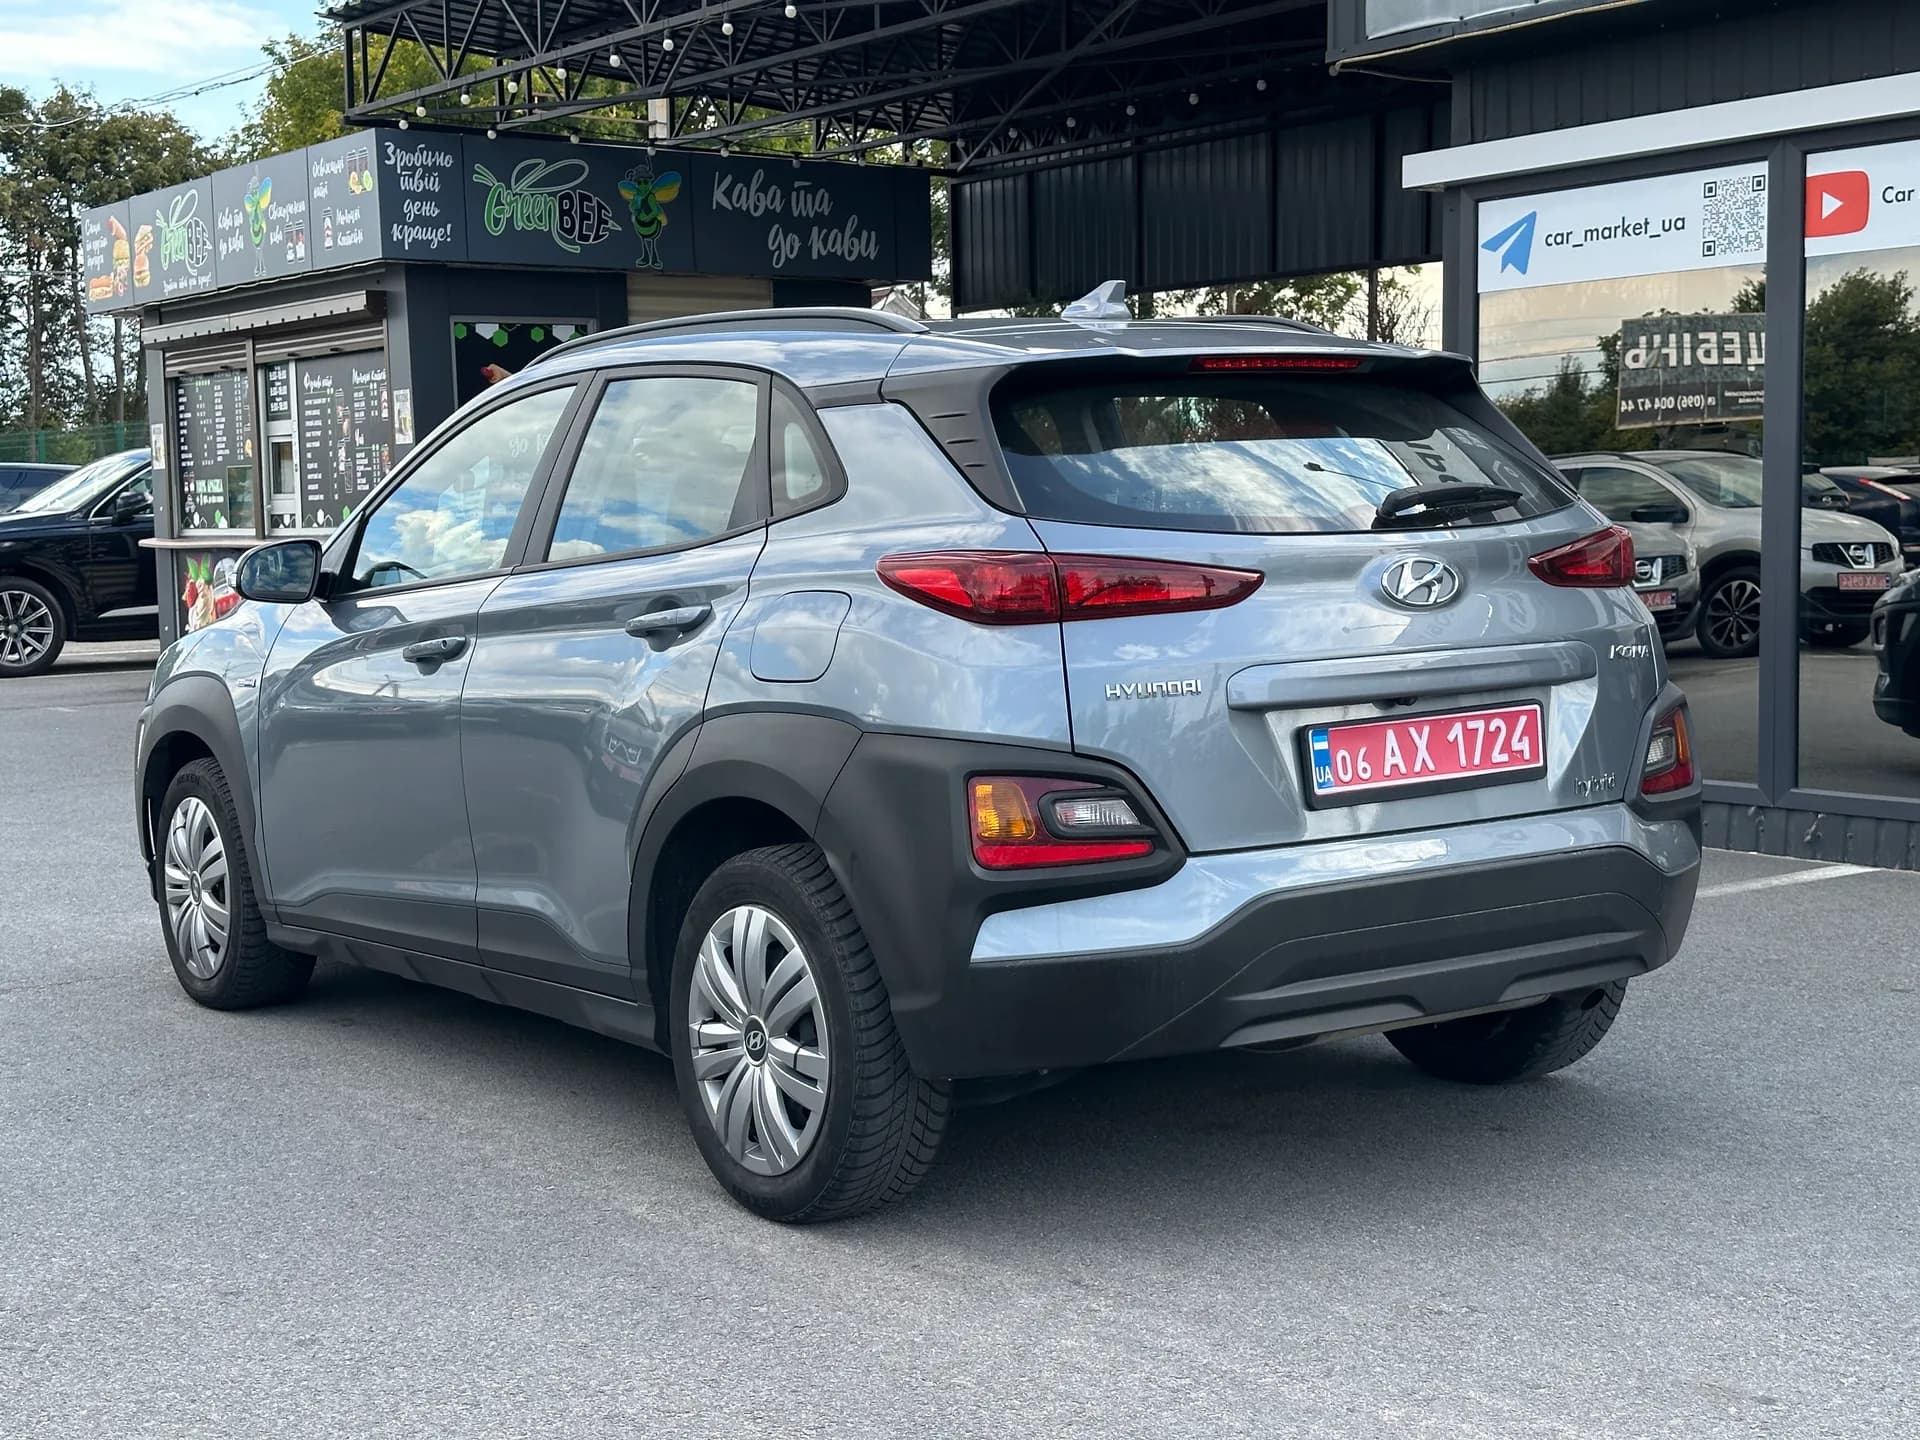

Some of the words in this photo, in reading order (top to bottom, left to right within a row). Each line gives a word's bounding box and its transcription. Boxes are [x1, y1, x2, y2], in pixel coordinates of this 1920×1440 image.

[384, 142, 453, 174] Зробимо
[400, 168, 441, 192] твій
[713, 169, 784, 216] Кава
[791, 181, 833, 218] та
[1882, 186, 1915, 204] Car
[403, 199, 440, 222] день
[391, 223, 452, 250] краще!
[768, 224, 802, 268] до
[808, 215, 879, 261] кави
[1544, 216, 1686, 248] car_market_ua
[1105, 680, 1201, 701] HYUNDAI
[1315, 766, 1333, 783] UA
[1336, 747, 1371, 783] 06
[1383, 725, 1436, 777] AX
[1447, 715, 1531, 768] 1724
[1575, 773, 1616, 797] hybrid
